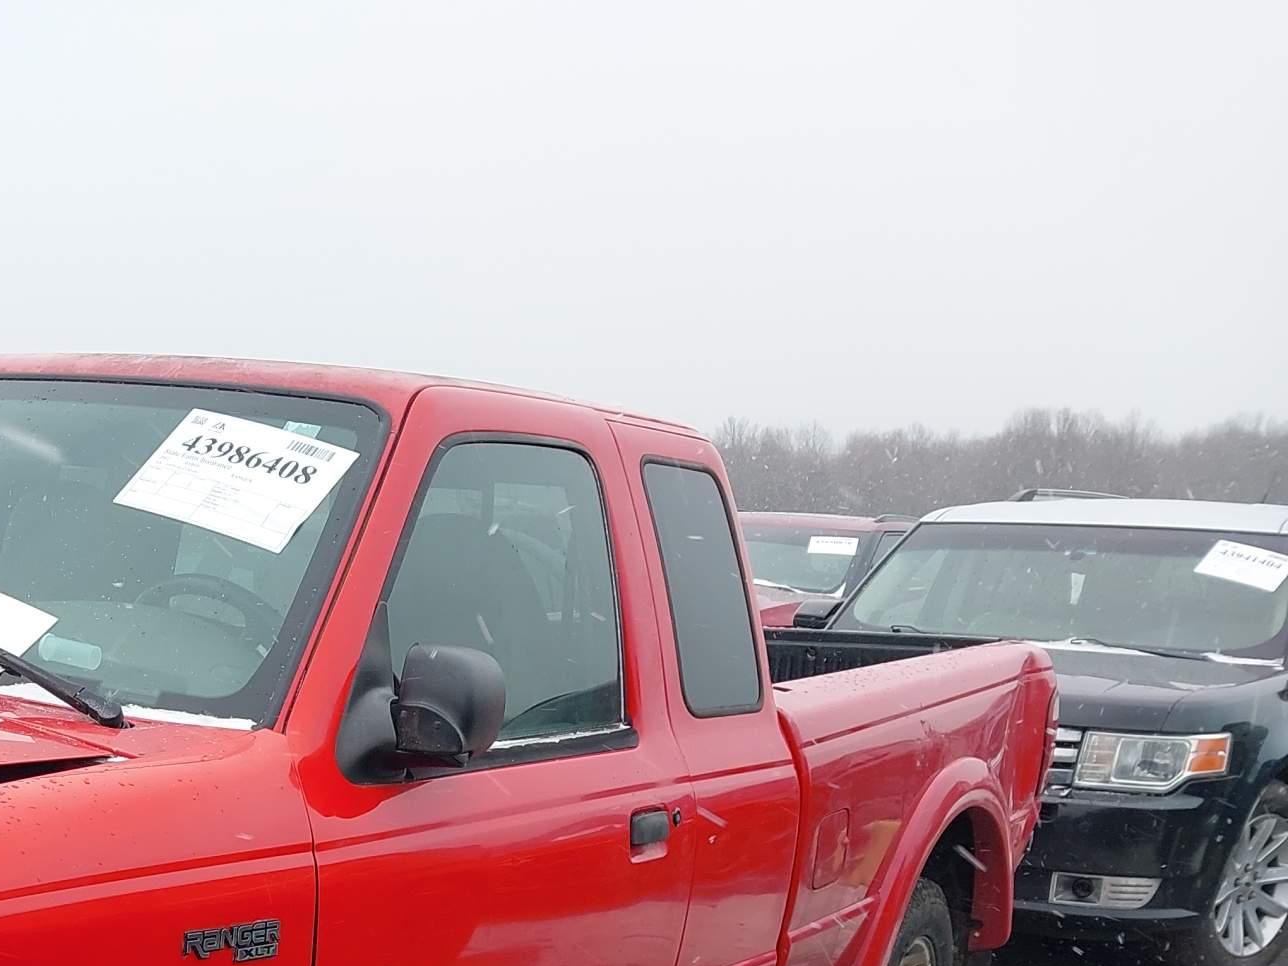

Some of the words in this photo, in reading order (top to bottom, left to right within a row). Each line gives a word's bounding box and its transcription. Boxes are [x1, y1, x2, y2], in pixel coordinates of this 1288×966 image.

[182, 435, 318, 485] 43986408
[183, 919, 280, 959] RANGER
[240, 944, 276, 958] XLT
